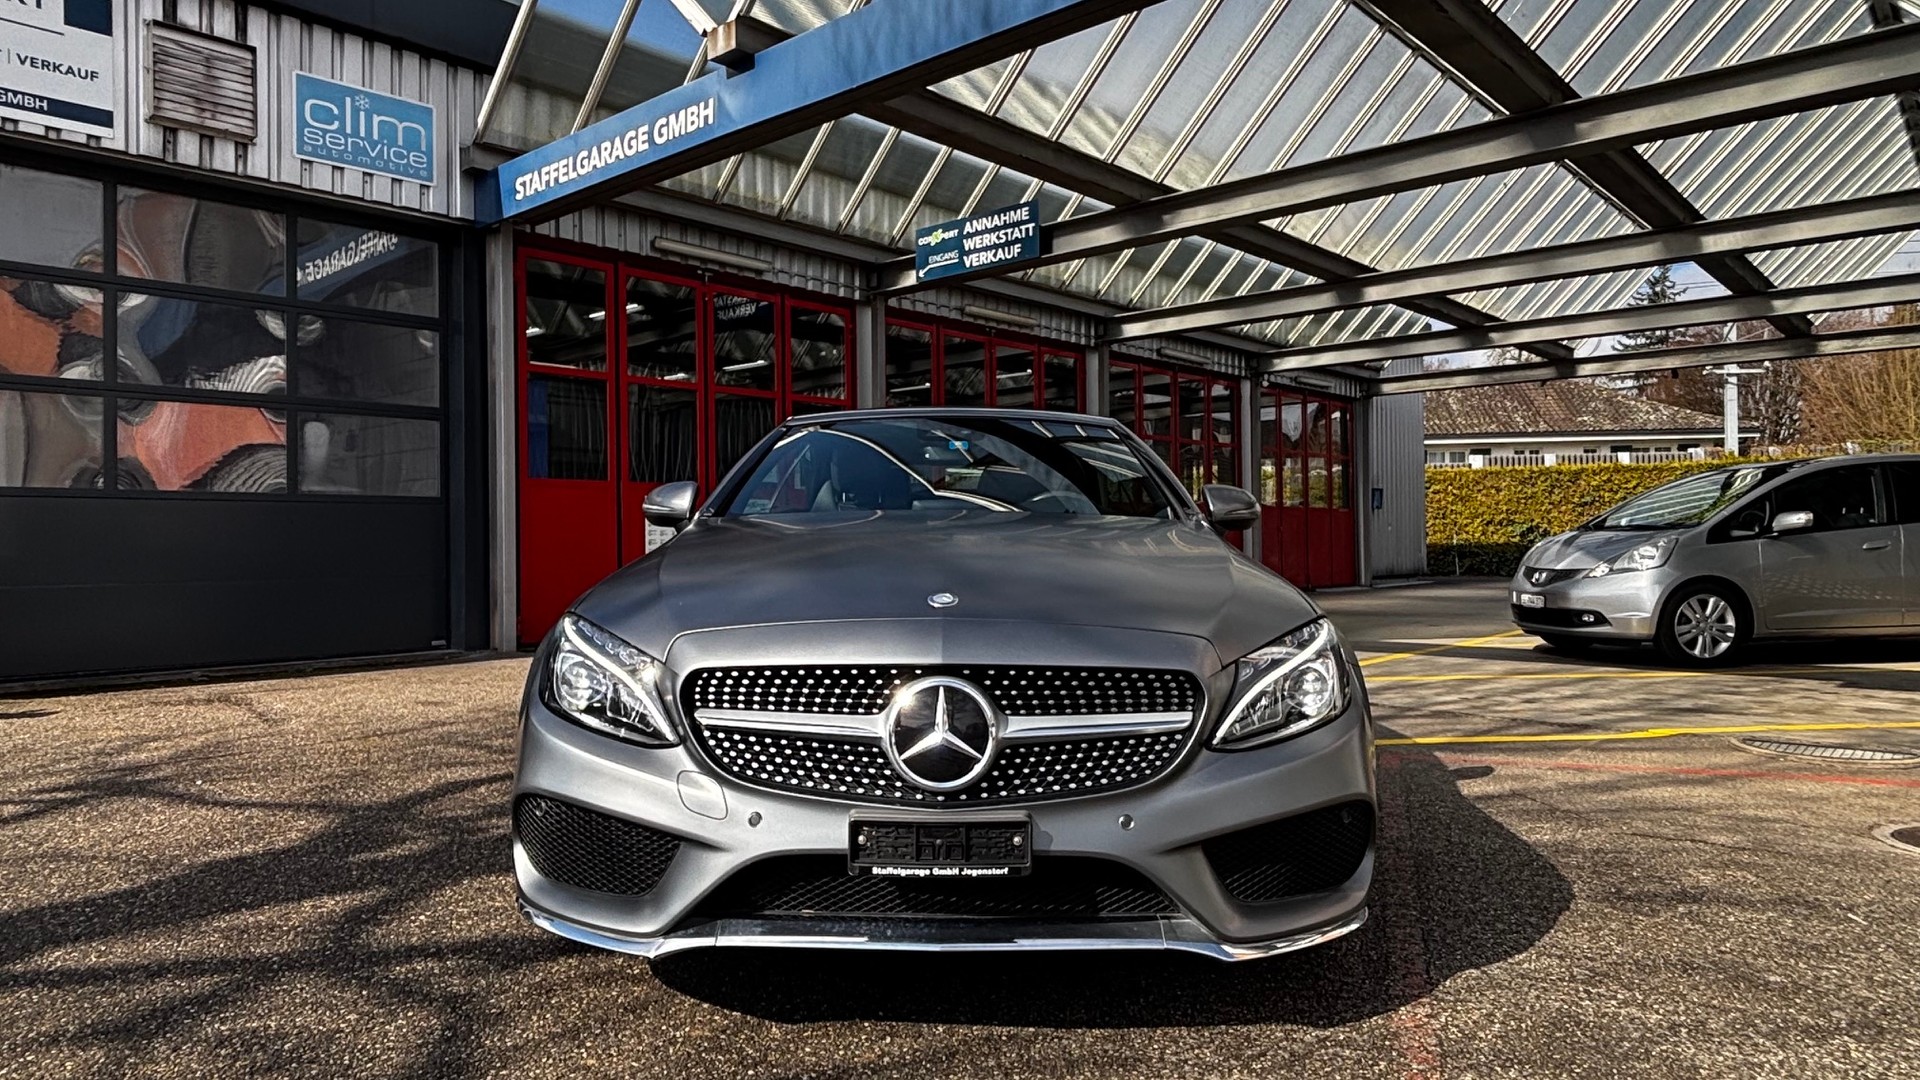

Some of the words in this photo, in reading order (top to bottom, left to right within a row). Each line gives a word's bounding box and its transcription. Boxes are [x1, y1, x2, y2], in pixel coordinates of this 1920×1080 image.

[16, 52, 100, 81] VERKAUF
[304, 95, 427, 151] clim
[303, 127, 427, 168] service
[303, 144, 428, 177] automotive
[514, 124, 649, 201] STAFFELGARAGE
[653, 97, 715, 145] GMBH
[963, 206, 1030, 235] ANNAHME
[963, 222, 1036, 251] WERKSTATT
[928, 250, 959, 264] EINGANG
[963, 243, 1023, 268] VERKAUF
[872, 866, 931, 877] Staffelgarage
[932, 867, 960, 875] GmbH
